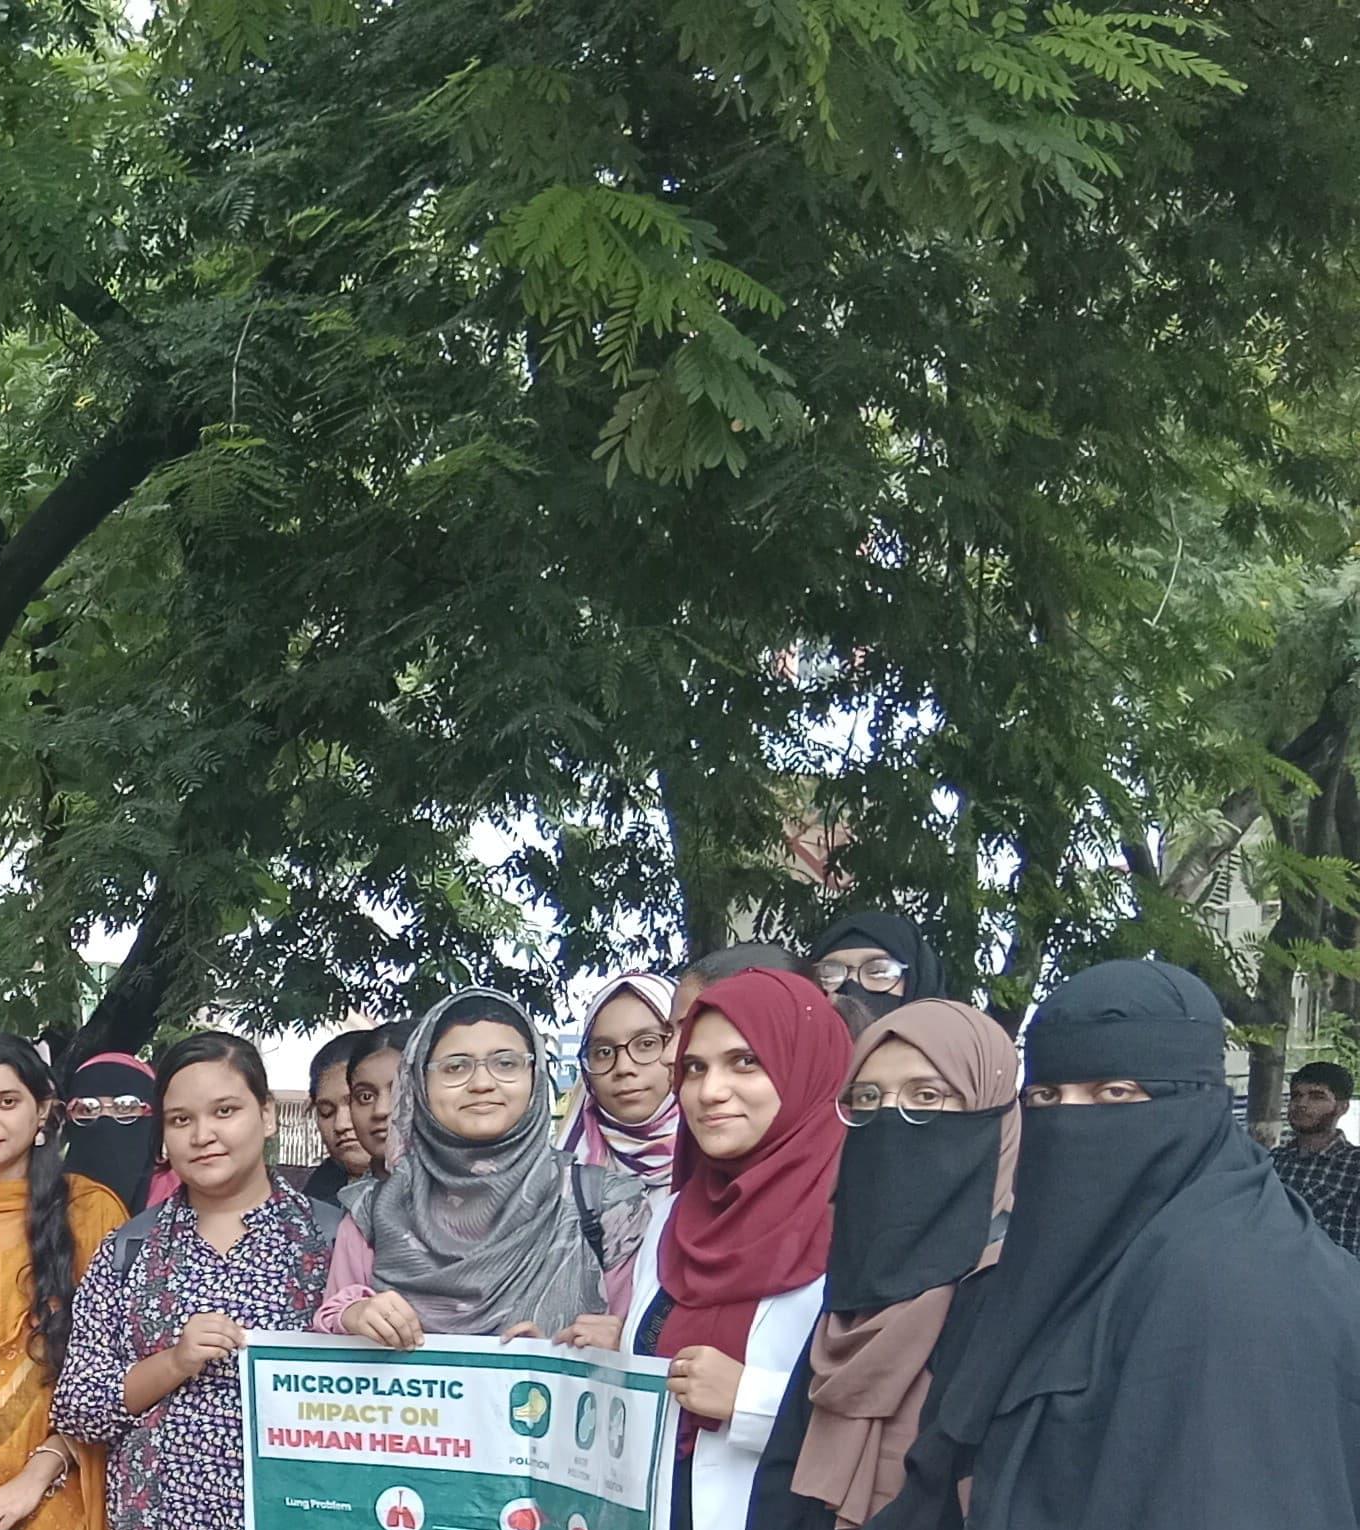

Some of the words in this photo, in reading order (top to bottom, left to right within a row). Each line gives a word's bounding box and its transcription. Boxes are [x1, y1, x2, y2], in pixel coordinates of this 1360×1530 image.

[273, 1374, 464, 1400] MICROPLASTIC
[298, 1402, 392, 1424] IMPACT
[400, 1406, 438, 1427] ON
[267, 1427, 362, 1451] HUMAN
[369, 1433, 471, 1458] HEALTH
[284, 1497, 310, 1510] Lung
[310, 1499, 352, 1511] Problem
